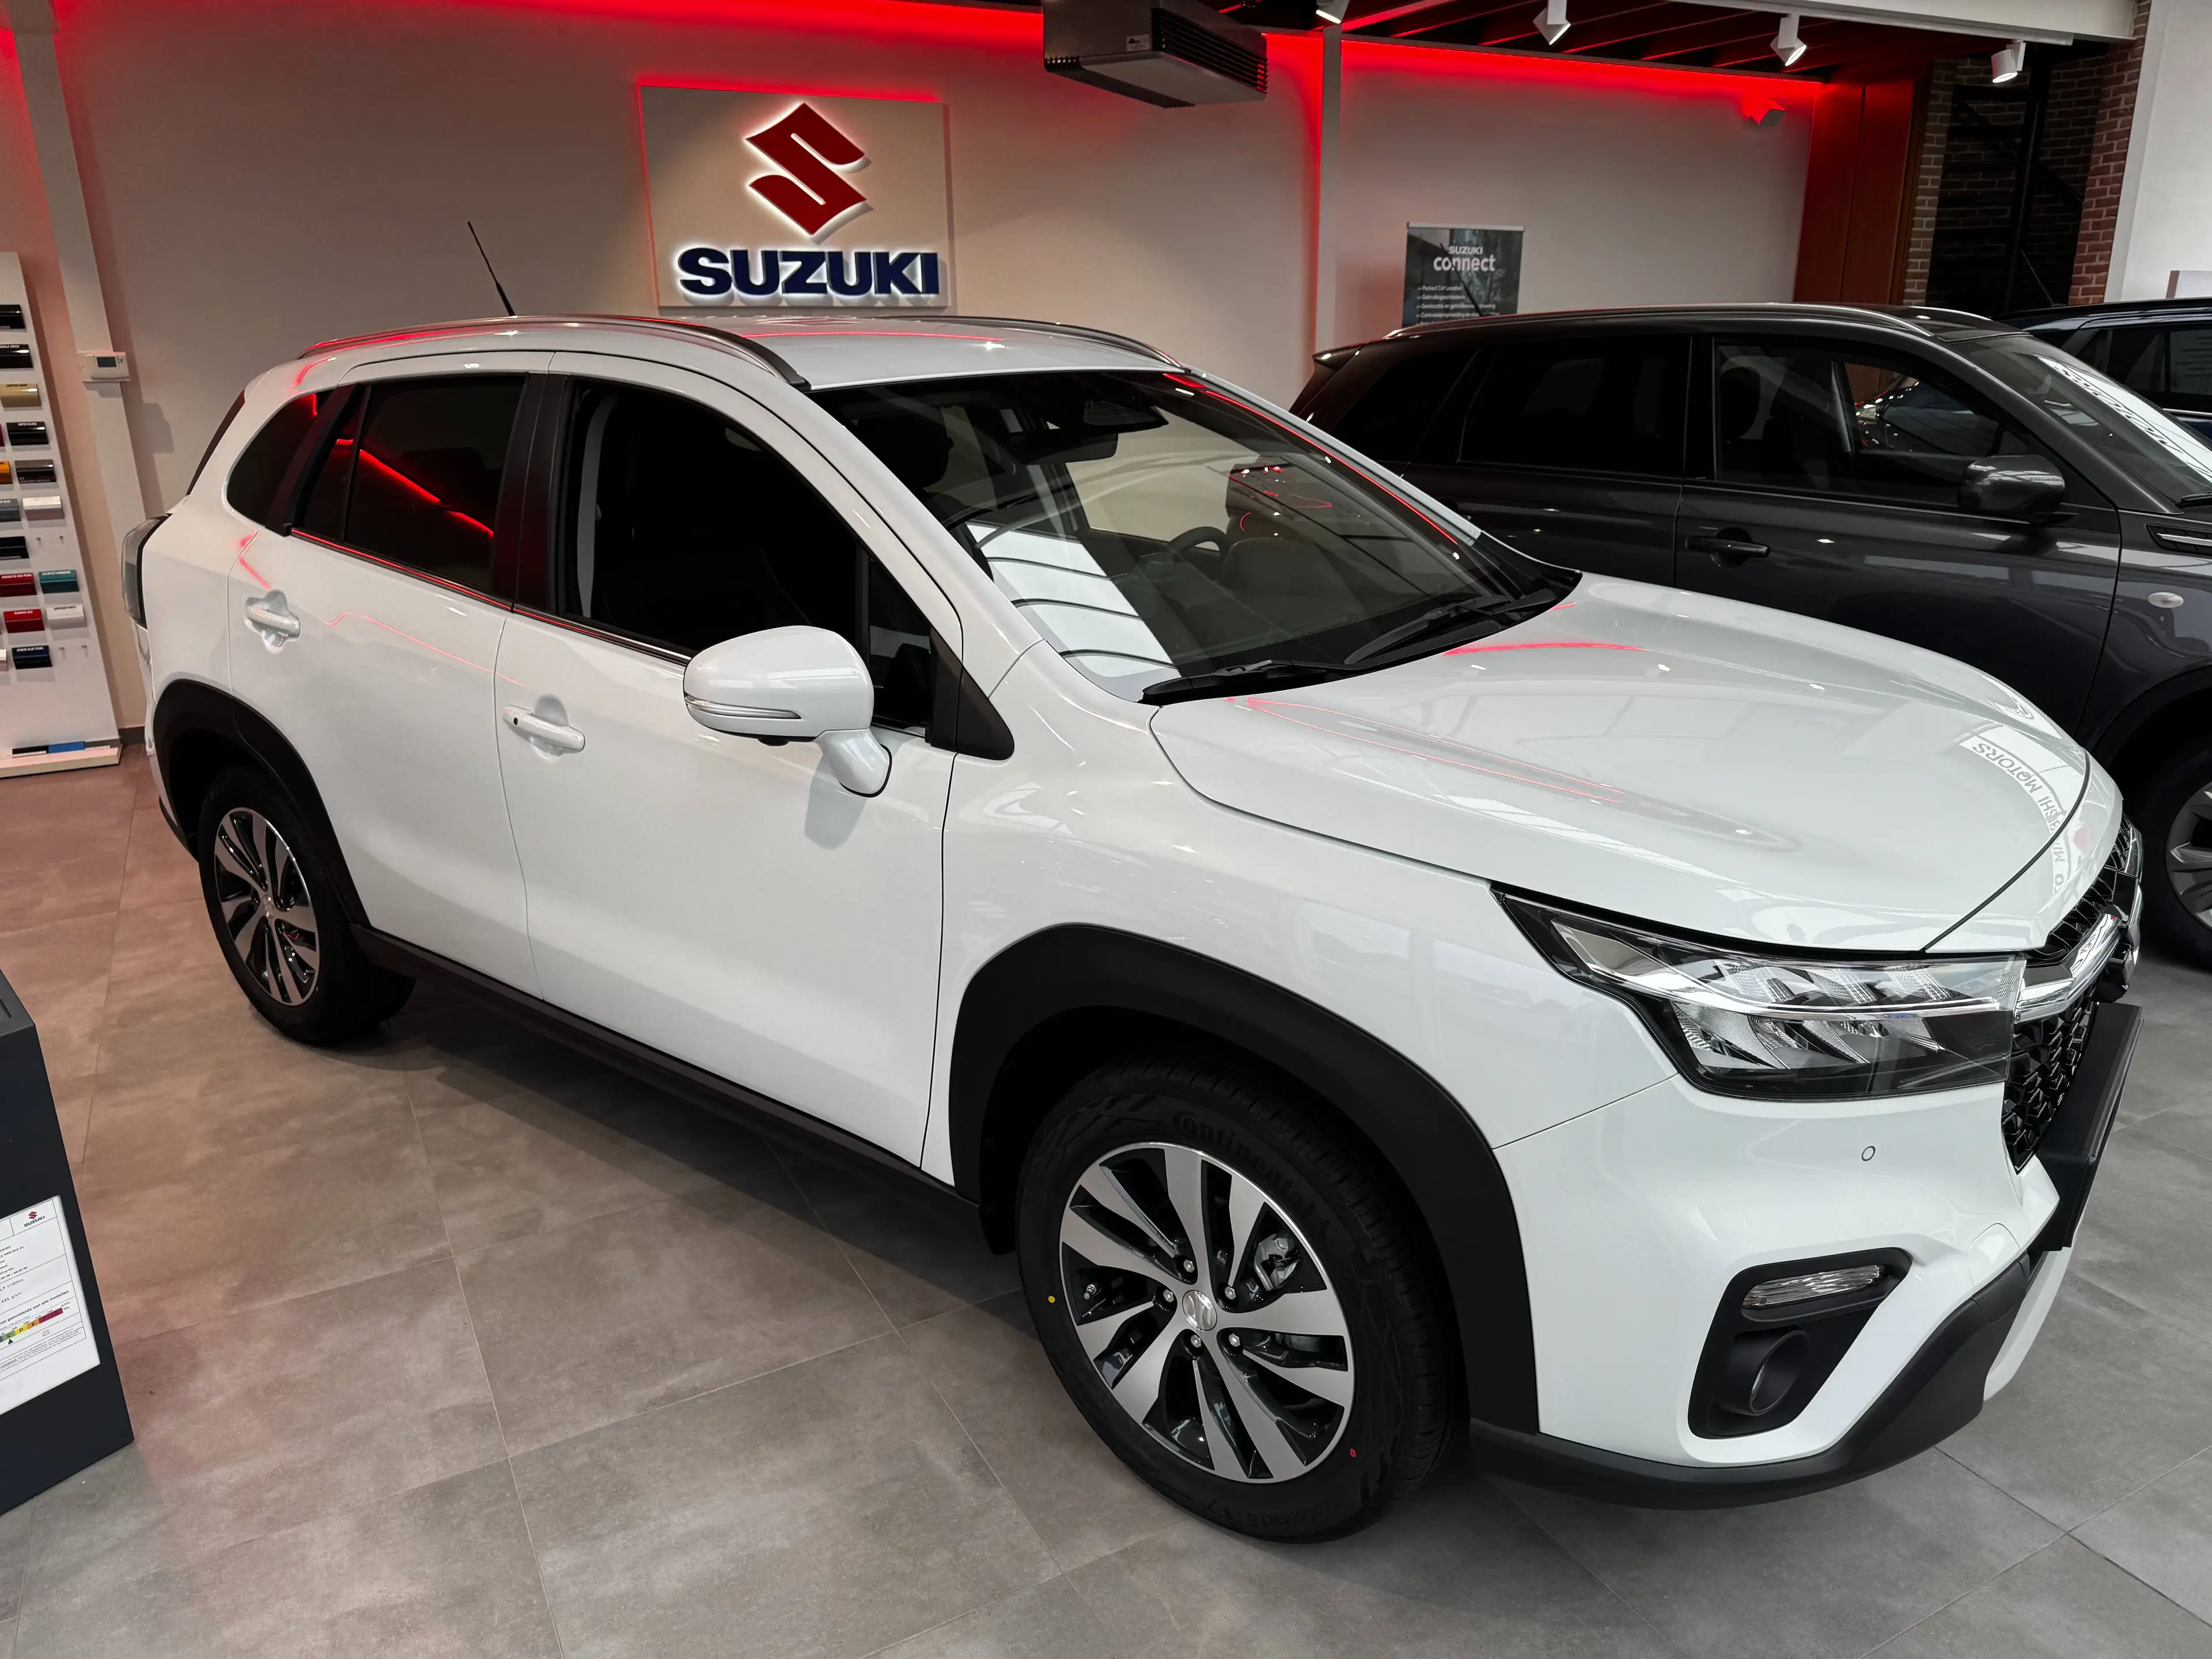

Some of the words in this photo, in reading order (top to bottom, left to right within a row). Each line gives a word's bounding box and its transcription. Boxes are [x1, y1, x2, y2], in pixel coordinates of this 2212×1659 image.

[1433, 254, 1497, 272] connect
[1448, 245, 1483, 255] SUZUKI
[678, 248, 940, 296] SUZUKI
[1972, 742, 2043, 794] MOTORS
[1172, 1109, 1317, 1215] Continental
[24, 1215, 45, 1227] SUZUKI
